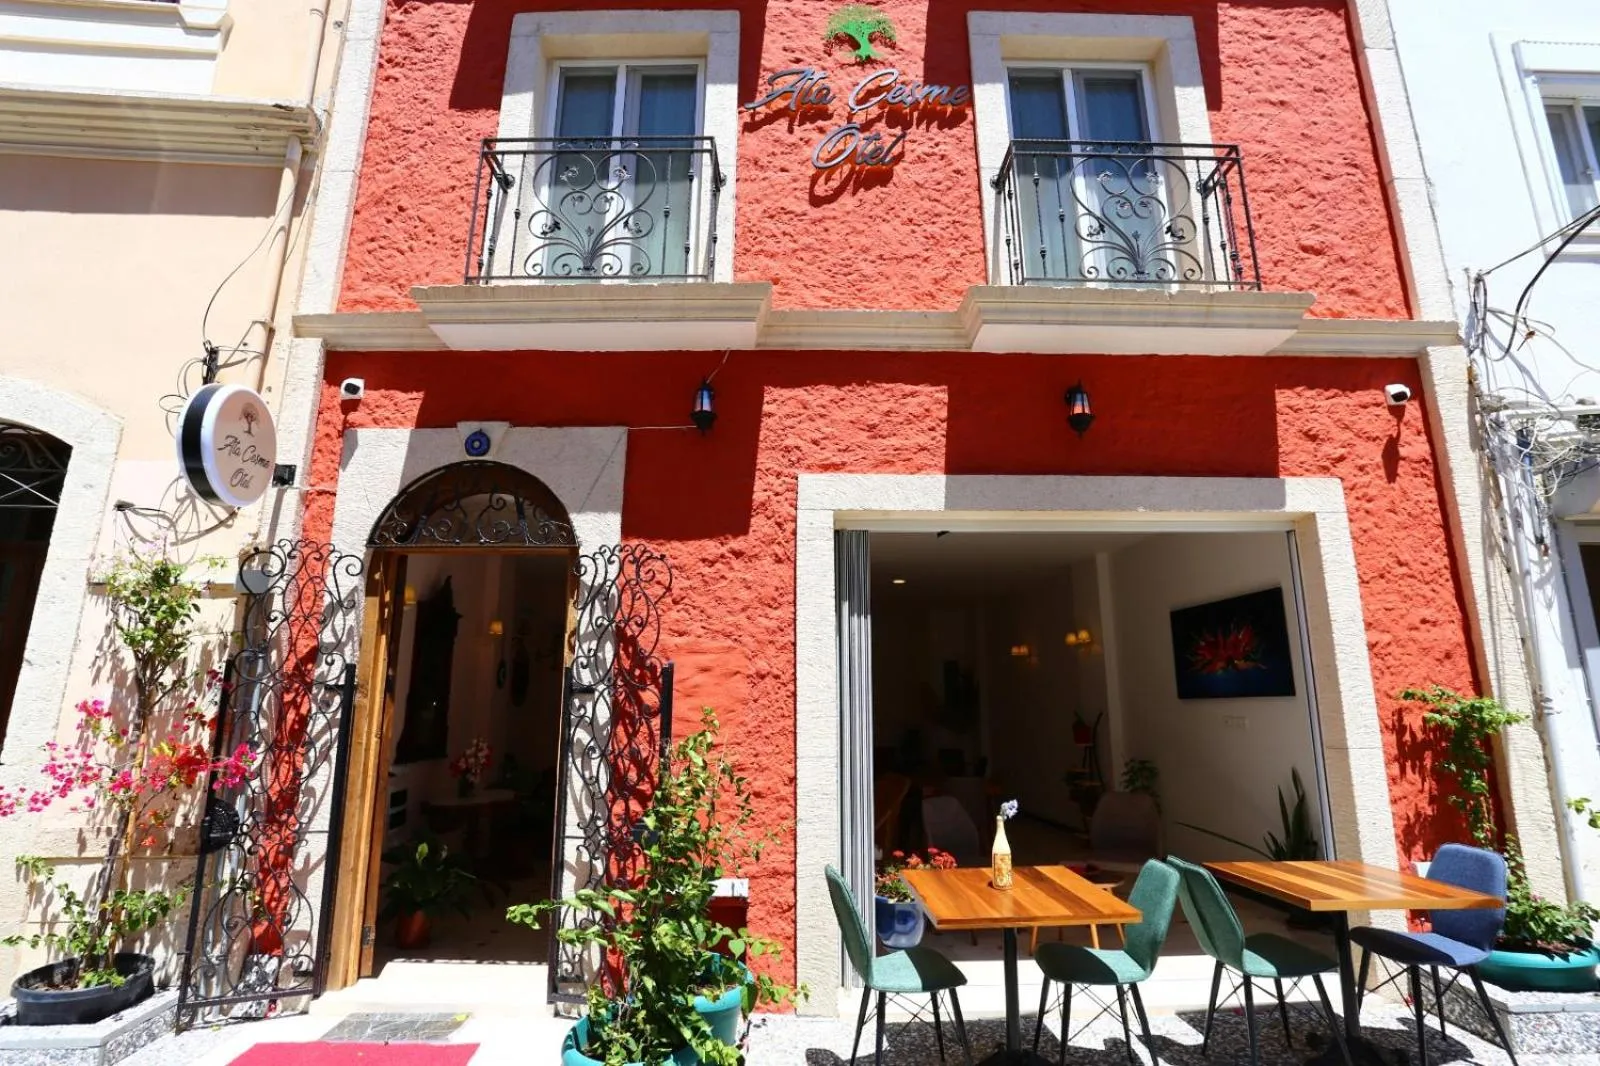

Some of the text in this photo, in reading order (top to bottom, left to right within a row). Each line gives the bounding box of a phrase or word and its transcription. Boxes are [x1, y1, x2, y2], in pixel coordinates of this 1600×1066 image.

[744, 67, 836, 111] Ata
[811, 122, 907, 169] Otel
[217, 434, 241, 457] Ata
